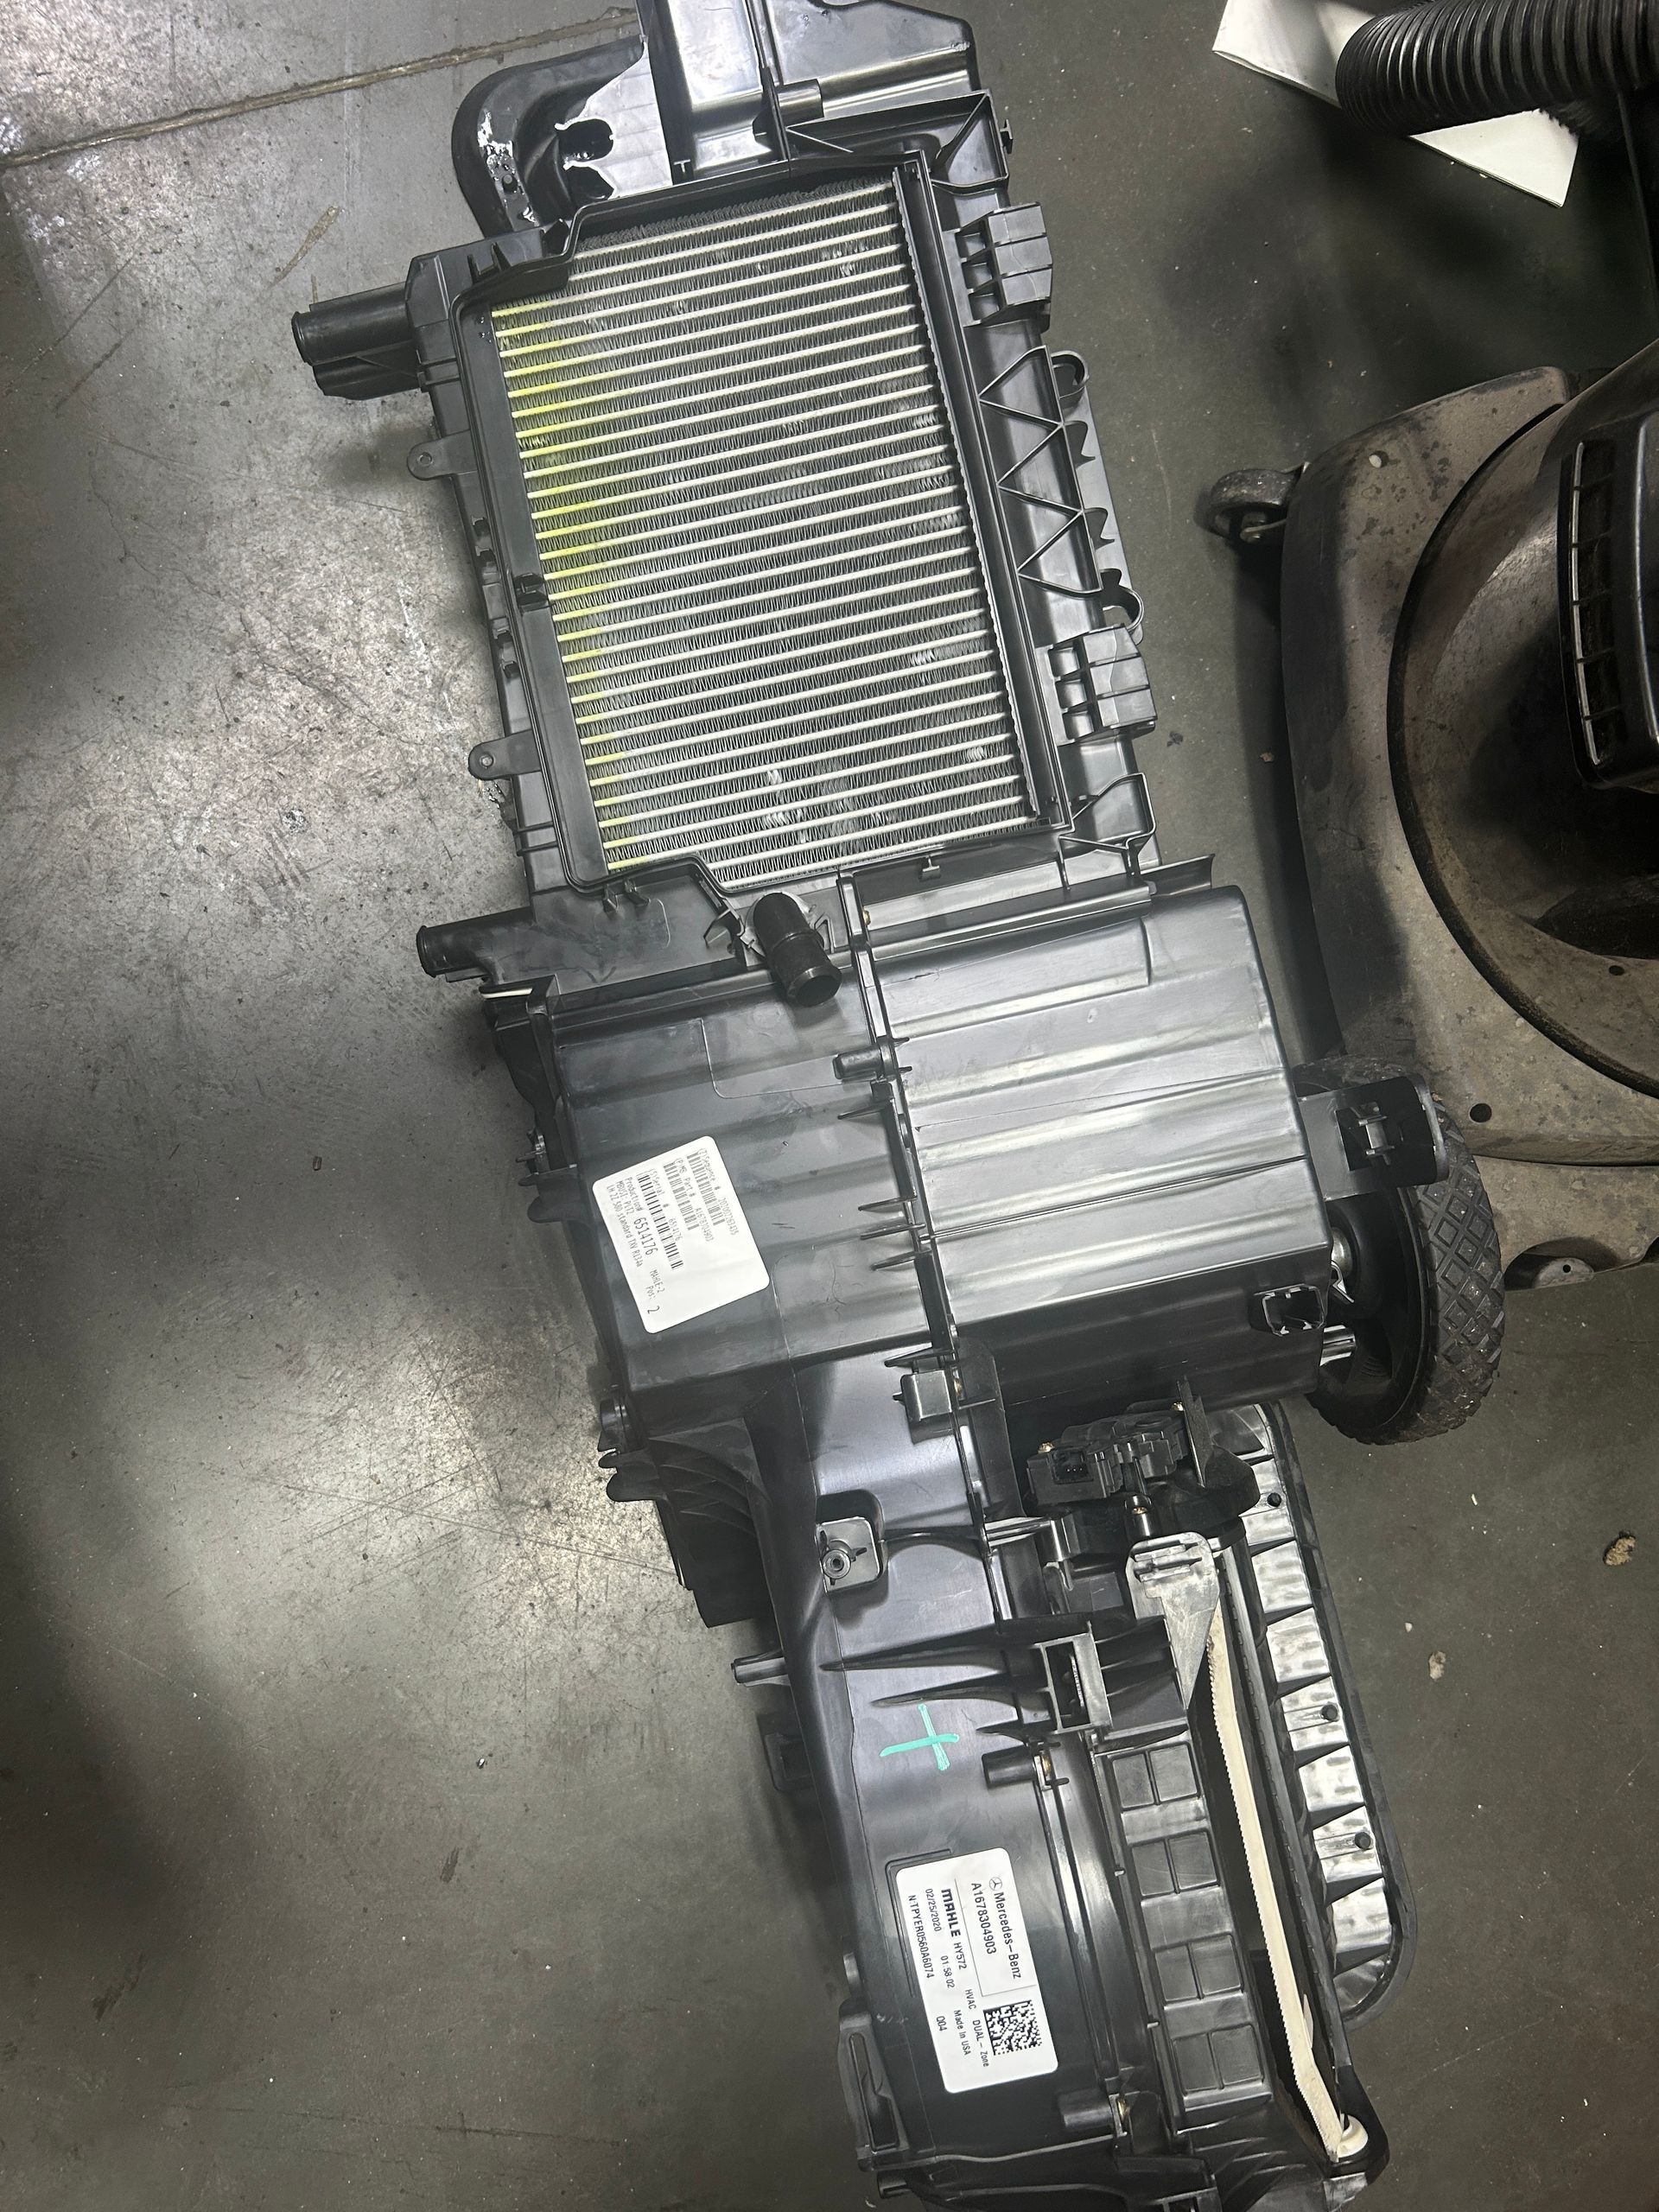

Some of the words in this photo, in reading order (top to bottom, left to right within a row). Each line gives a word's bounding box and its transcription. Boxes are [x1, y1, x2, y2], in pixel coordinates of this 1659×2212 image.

[624, 1177, 645, 1211] Production#
[683, 1177, 693, 1191] Part
[693, 1207, 715, 1242] A1678304903
[617, 1213, 633, 1238] standard
[633, 1217, 658, 1255] 6514176
[668, 1218, 683, 1241] 6514176
[627, 1238, 638, 1249] TXV
[632, 1249, 643, 1267] R134a
[645, 1285, 656, 1300] Pos:
[649, 1269, 665, 1293] MAHLE-2
[647, 1305, 660, 1314] 2
[971, 1883, 996, 1955] A1678304903
[994, 1891, 1021, 1979] Mercedes-Benz
[908, 1895, 935, 1978] N:TPYER0560A6074
[925, 1888, 942, 1931] 02/25/2020
[940, 1955, 955, 1988] 01:58:02
[954, 2010, 963, 2030] Made
[961, 2040, 971, 2056] USA
[941, 1888, 961, 1937] MAHLE
[953, 1942, 967, 1969] HY572
[964, 1989, 976, 2010] HVAC
[980, 2050, 989, 2067] Zone
